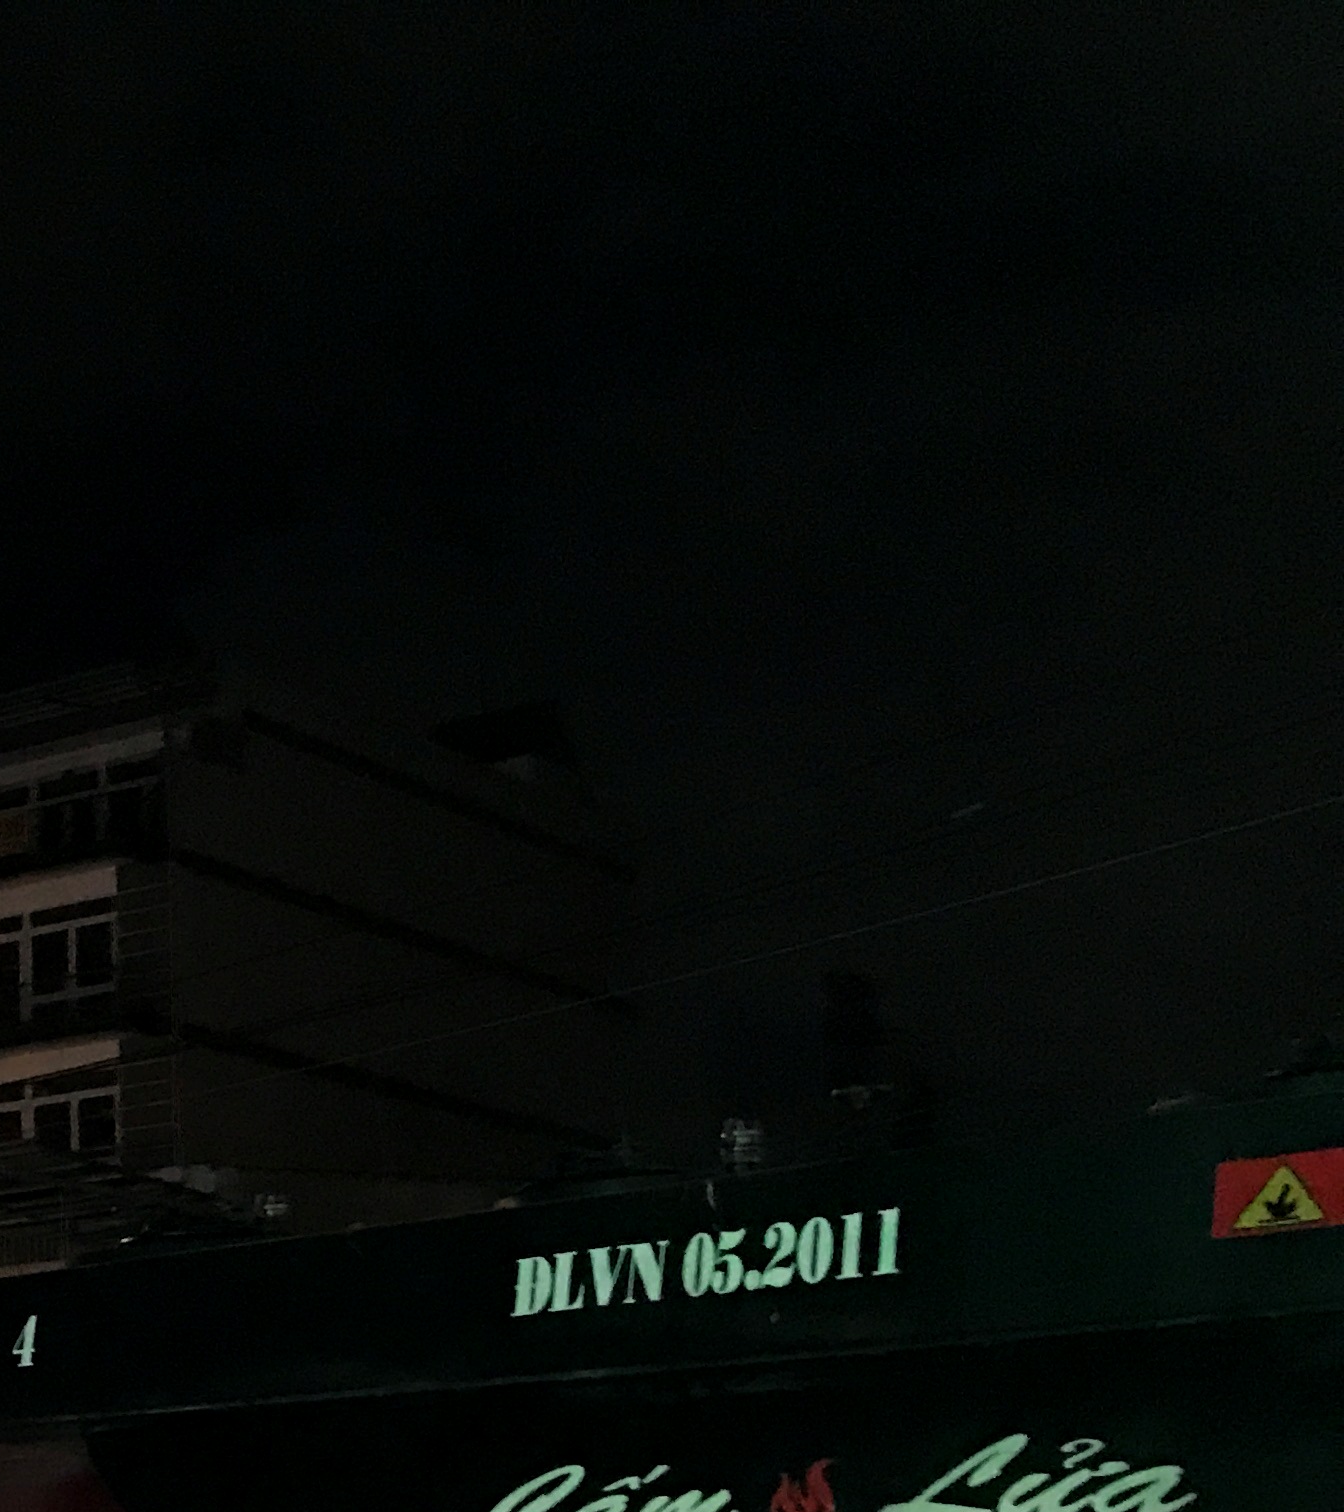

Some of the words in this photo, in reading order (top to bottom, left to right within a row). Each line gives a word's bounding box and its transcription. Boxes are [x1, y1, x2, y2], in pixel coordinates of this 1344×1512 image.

[510, 1239, 670, 1318] ĐLVN
[681, 1206, 901, 1298] 05.2011
[12, 1313, 38, 1367] 4
